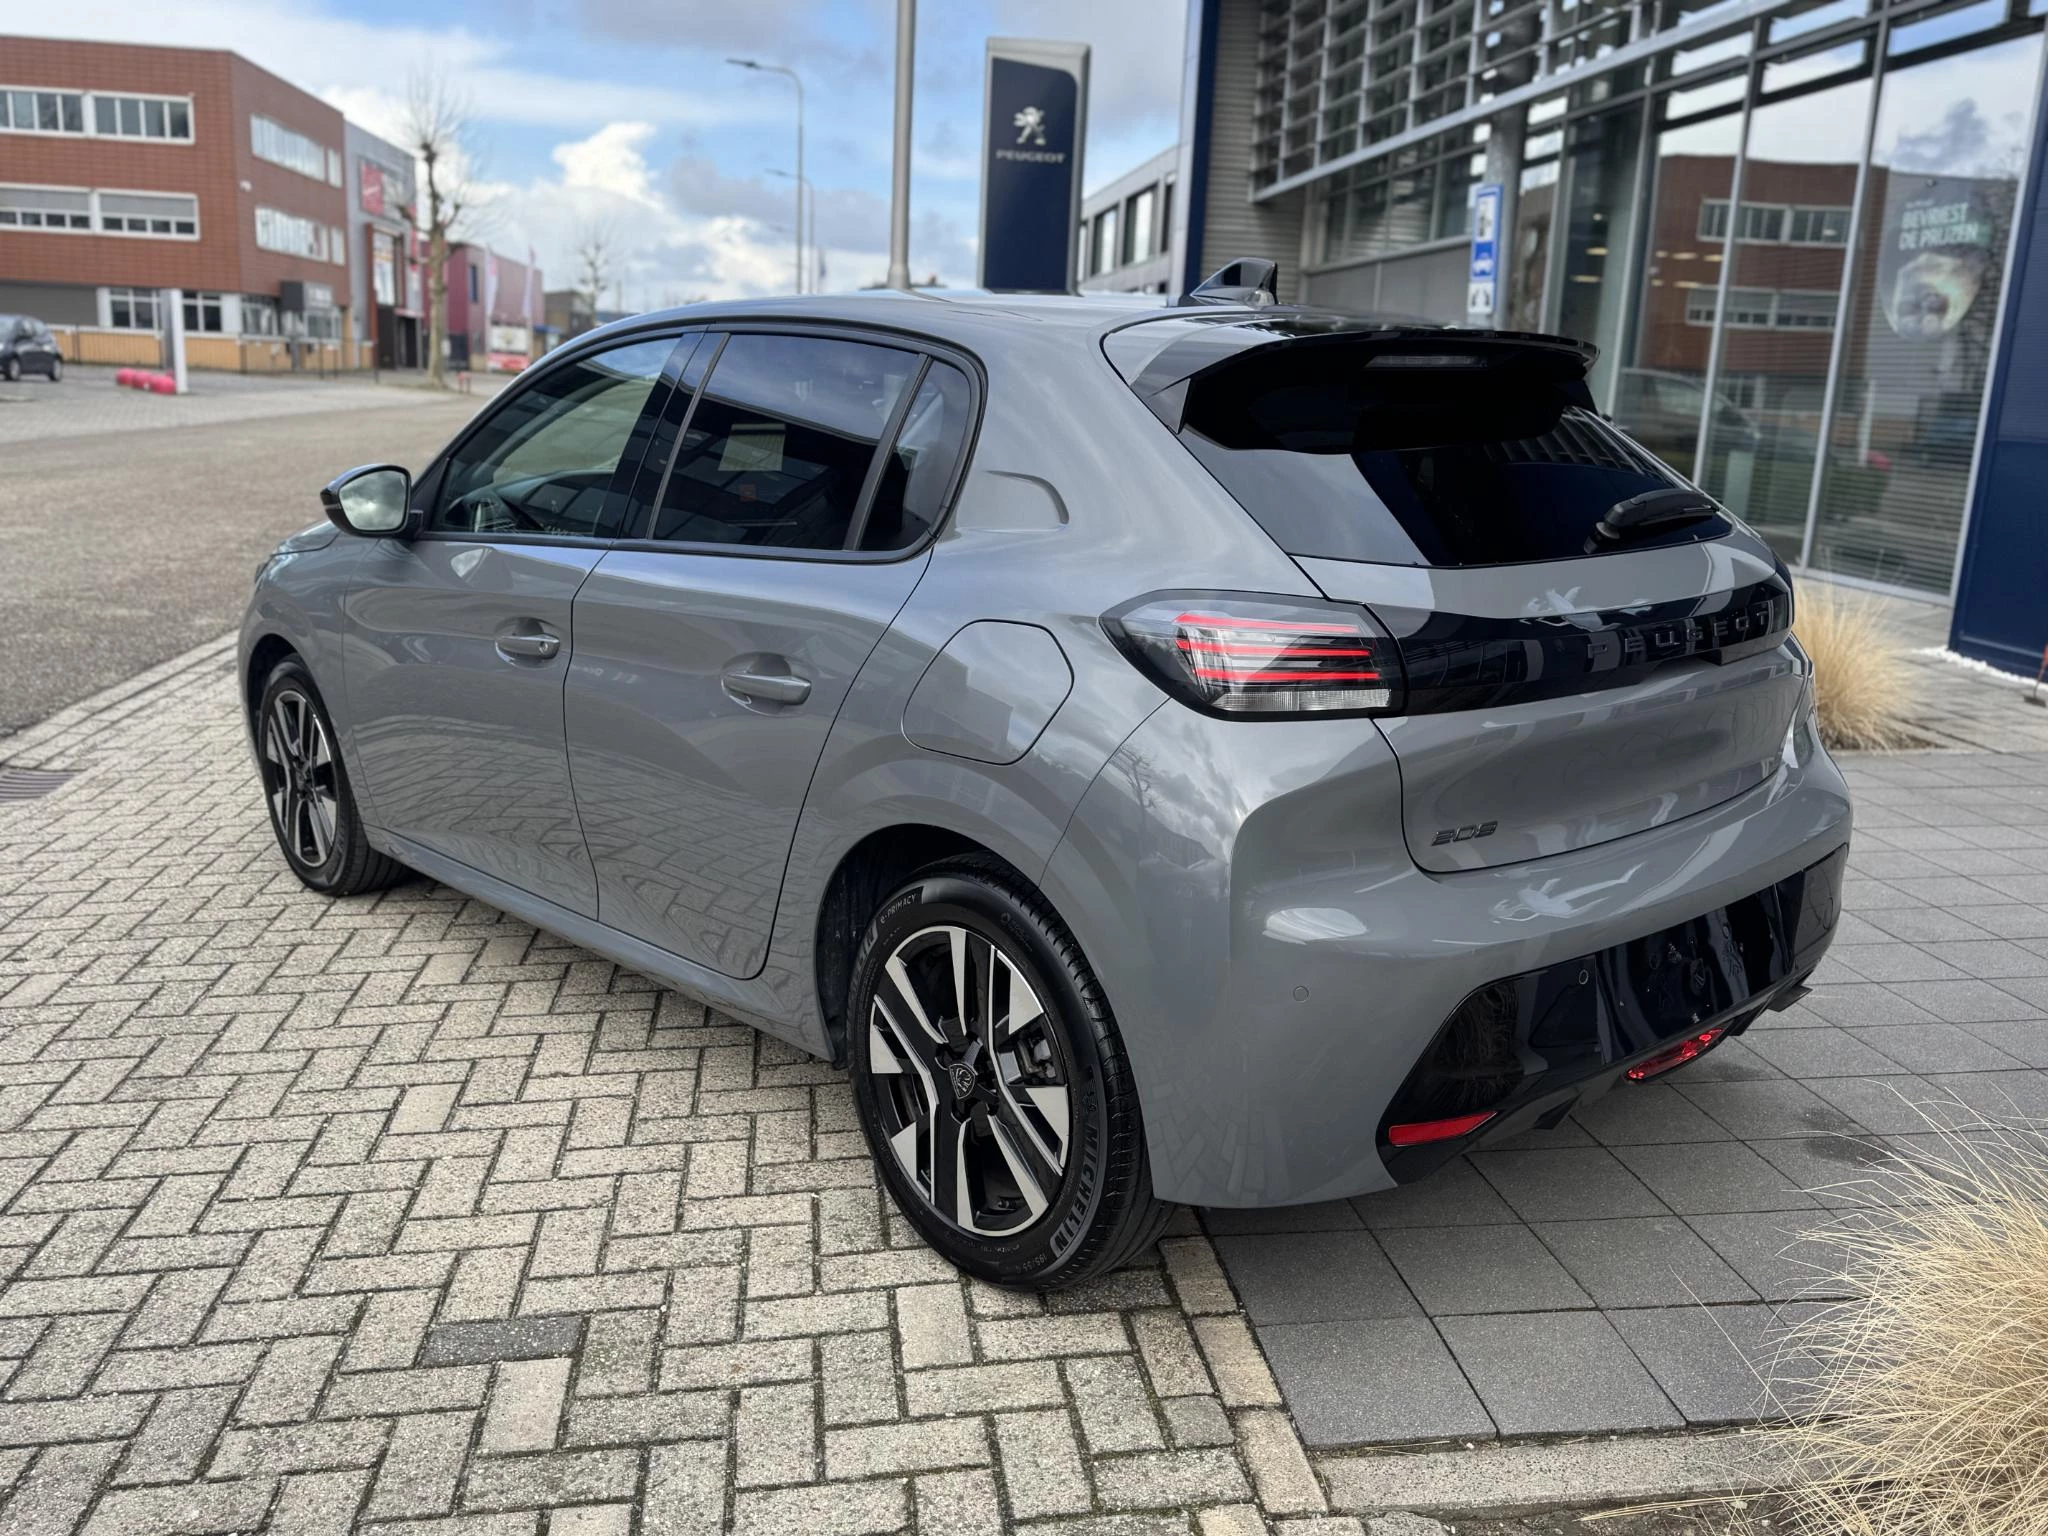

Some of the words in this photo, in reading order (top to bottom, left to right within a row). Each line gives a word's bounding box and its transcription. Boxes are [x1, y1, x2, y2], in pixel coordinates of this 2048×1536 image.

[996, 149, 1066, 164] PEUGEOT
[1899, 230, 1918, 251] DE
[1587, 610, 1768, 660] PEUGEOT
[1431, 820, 1498, 847] 208
[1054, 1123, 1098, 1252] MICHELIN
